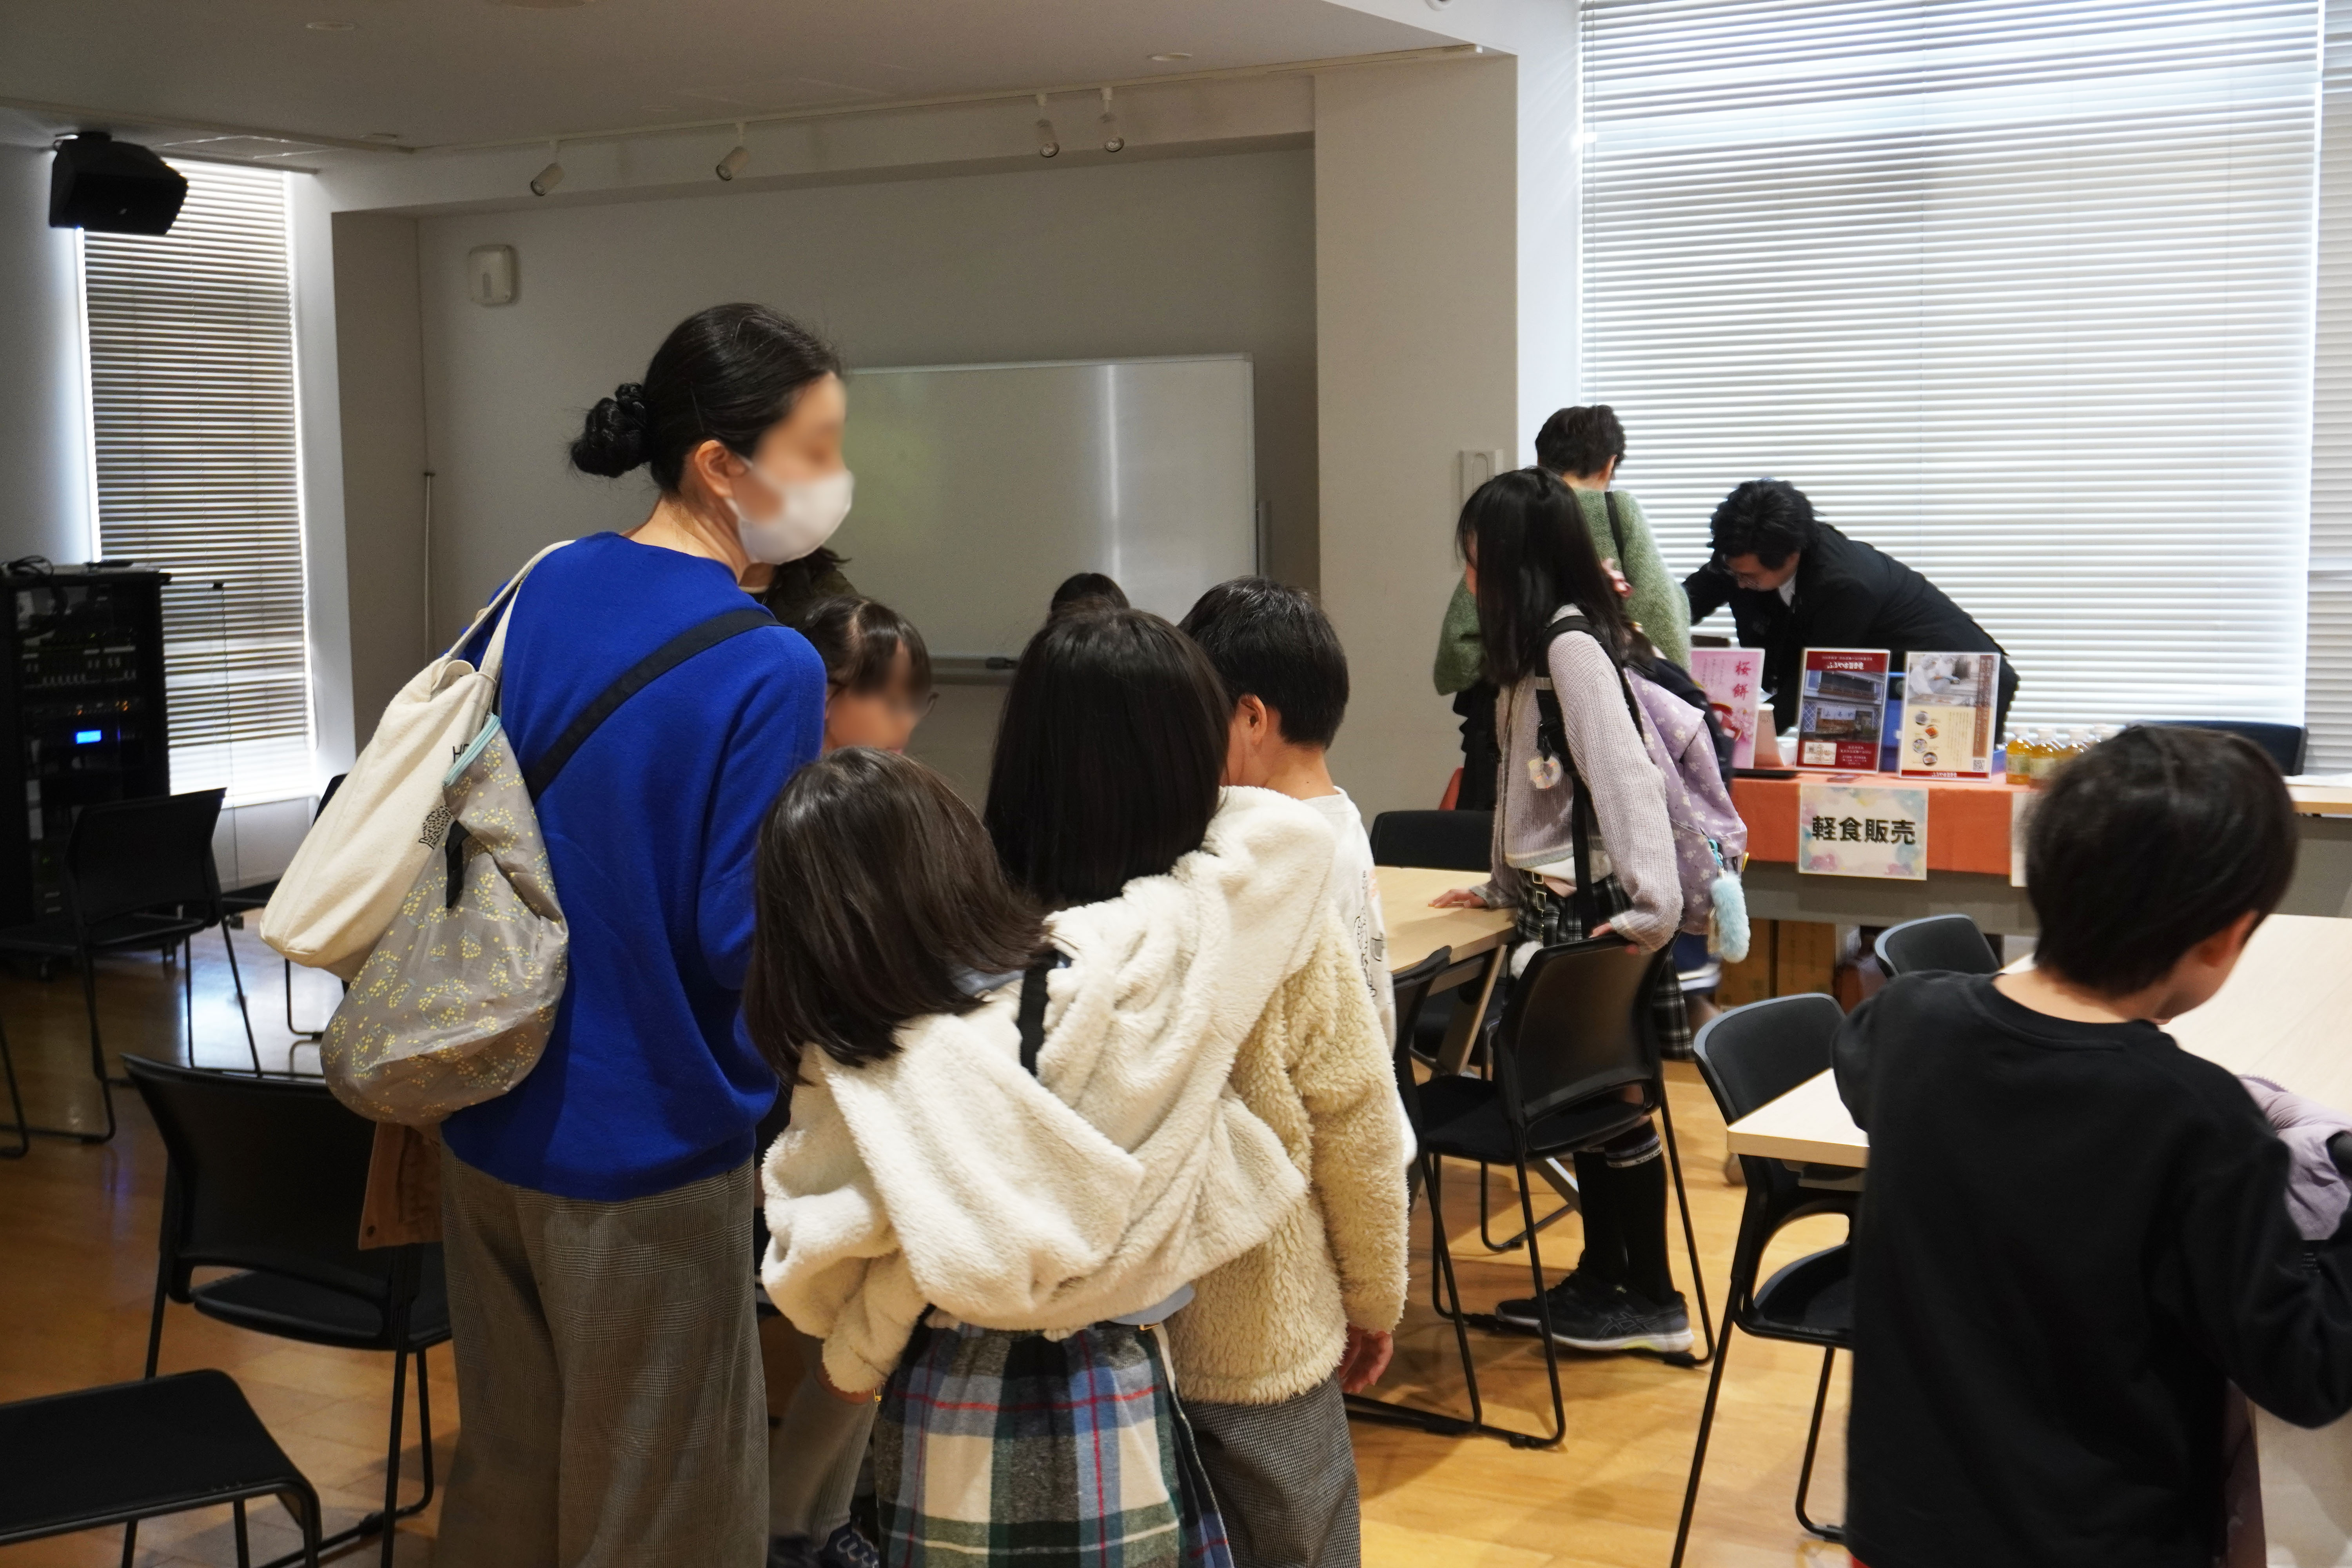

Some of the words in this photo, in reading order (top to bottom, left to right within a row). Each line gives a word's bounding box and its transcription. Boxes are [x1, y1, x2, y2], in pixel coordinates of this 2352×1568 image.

[1733, 661, 1751, 700] 桜餅
[1812, 815, 1916, 845] 軽食販売
